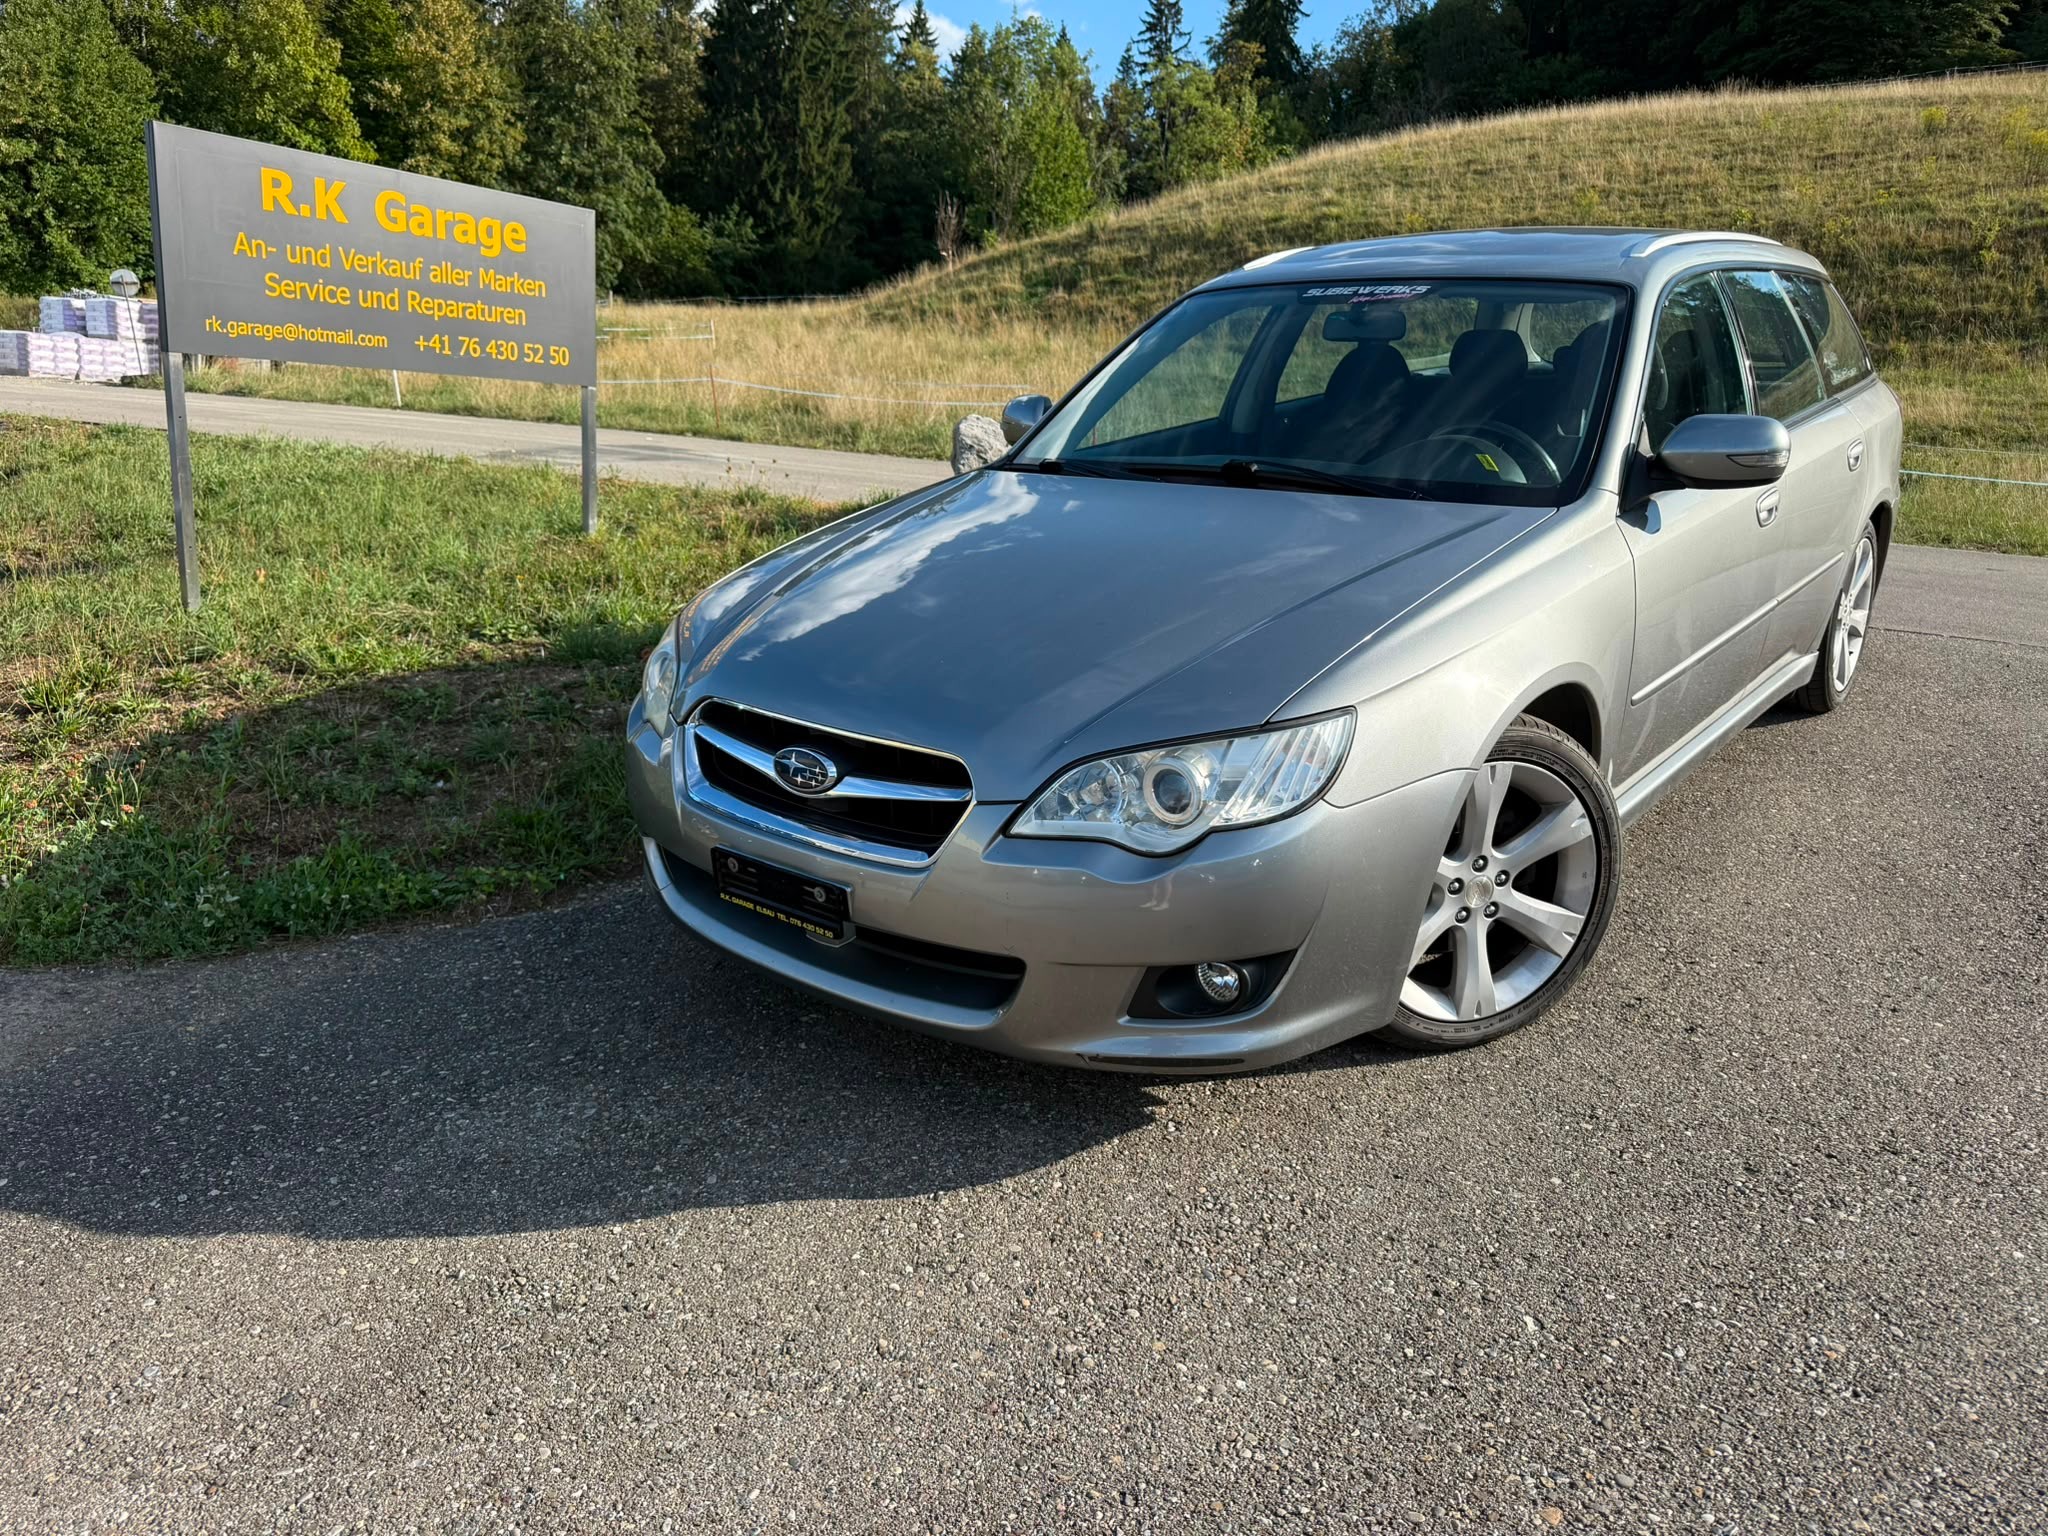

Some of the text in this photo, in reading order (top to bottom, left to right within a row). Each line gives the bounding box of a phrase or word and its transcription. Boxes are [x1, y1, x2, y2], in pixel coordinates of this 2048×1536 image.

[260, 166, 528, 258] R.K Garage
[233, 231, 547, 298] An- und Verkauf aller Marken
[264, 272, 527, 326] Service und Reparaturen
[205, 316, 388, 348] rk.garage@hotmail.com
[415, 334, 570, 367] +41 76 430 52 50
[731, 896, 755, 911] GARAGE
[825, 930, 834, 939] 50
